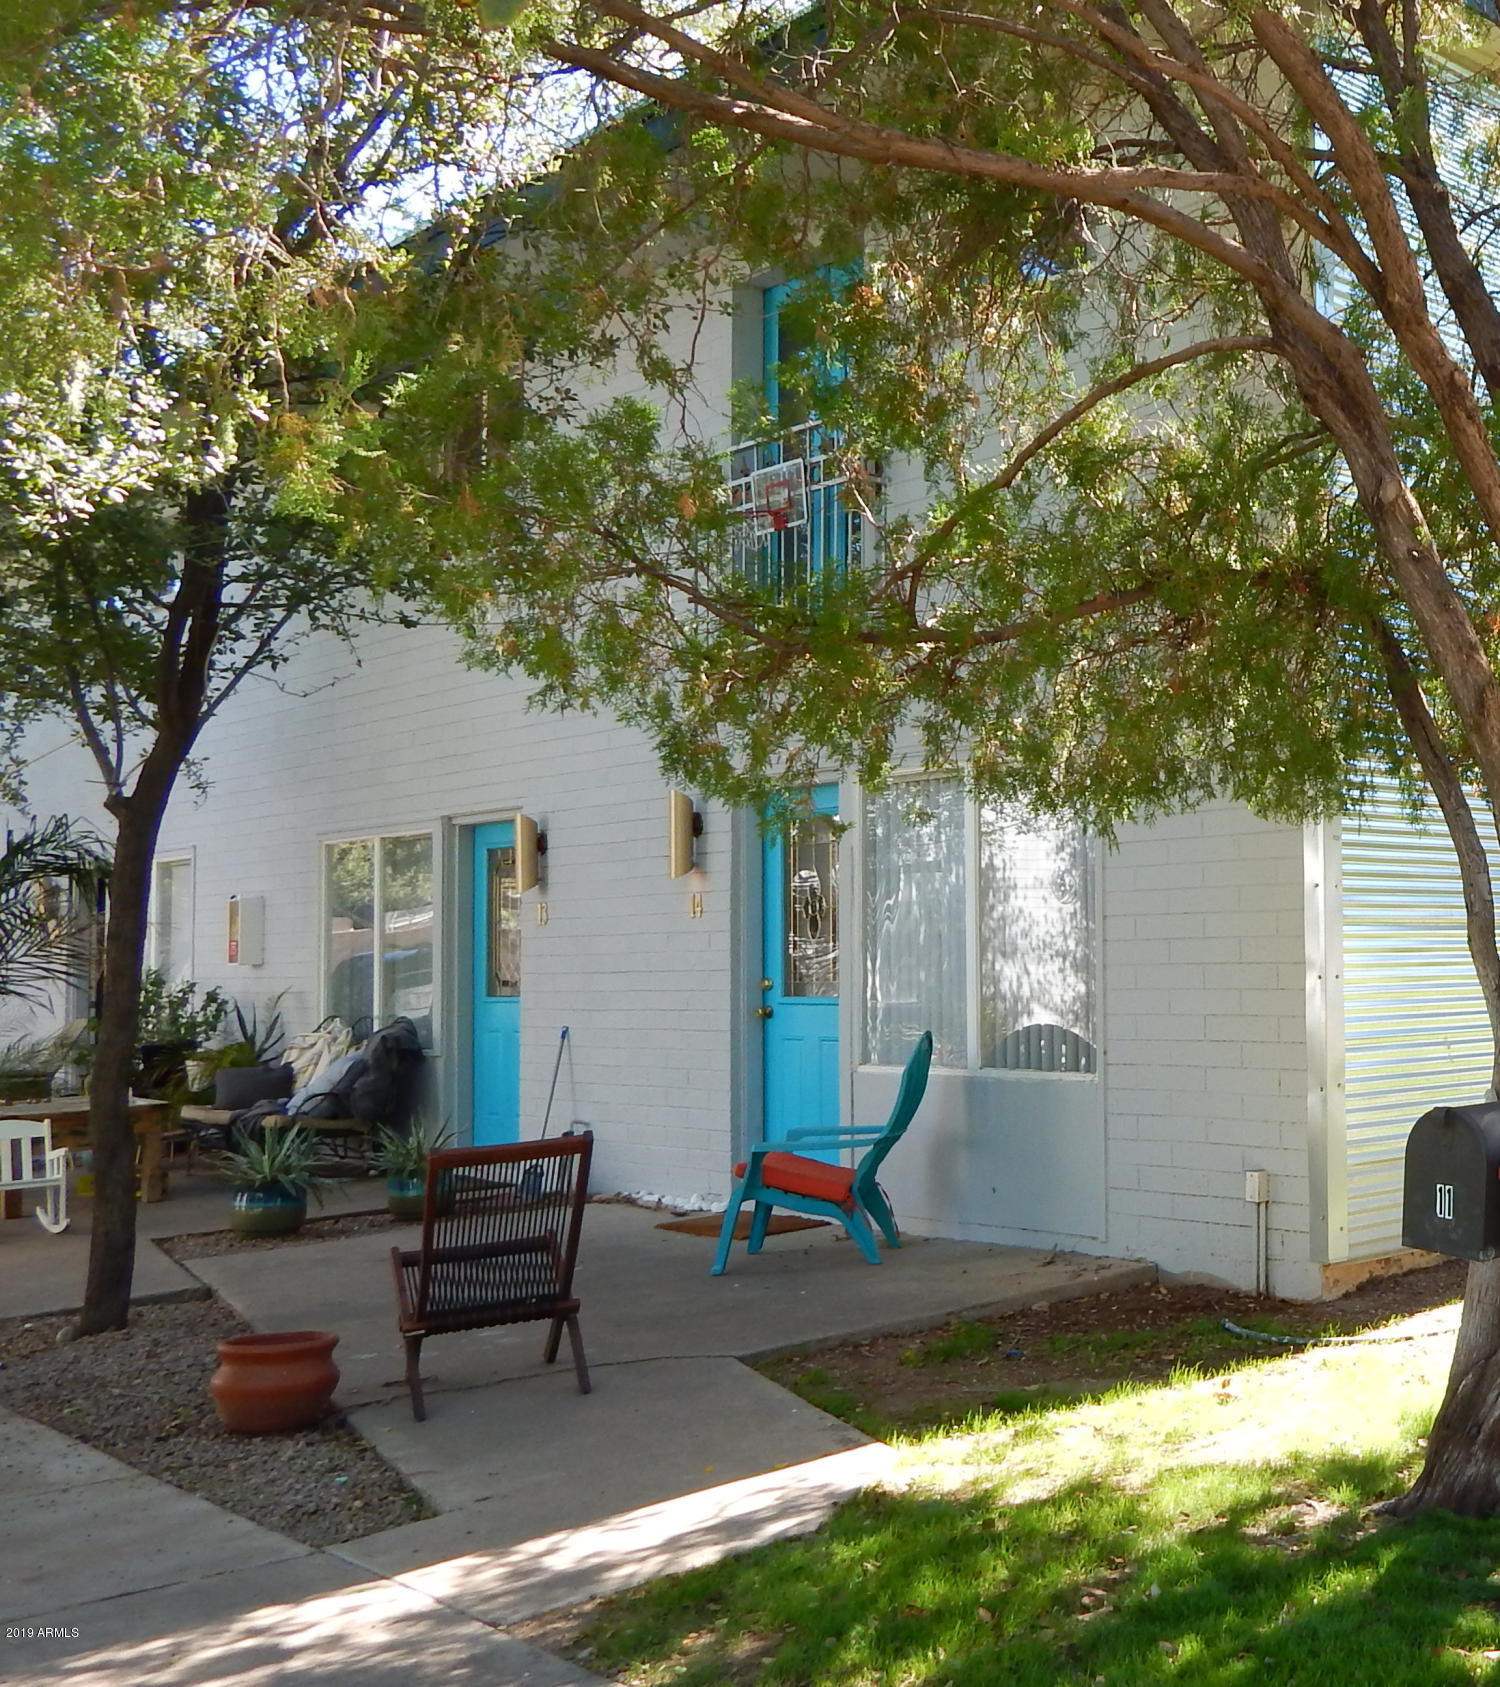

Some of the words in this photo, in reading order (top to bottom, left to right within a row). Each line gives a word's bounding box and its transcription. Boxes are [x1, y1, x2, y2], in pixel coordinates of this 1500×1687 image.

[537, 903, 549, 926] 13
[690, 892, 703, 919] 14
[1438, 1186, 1451, 1218] 11
